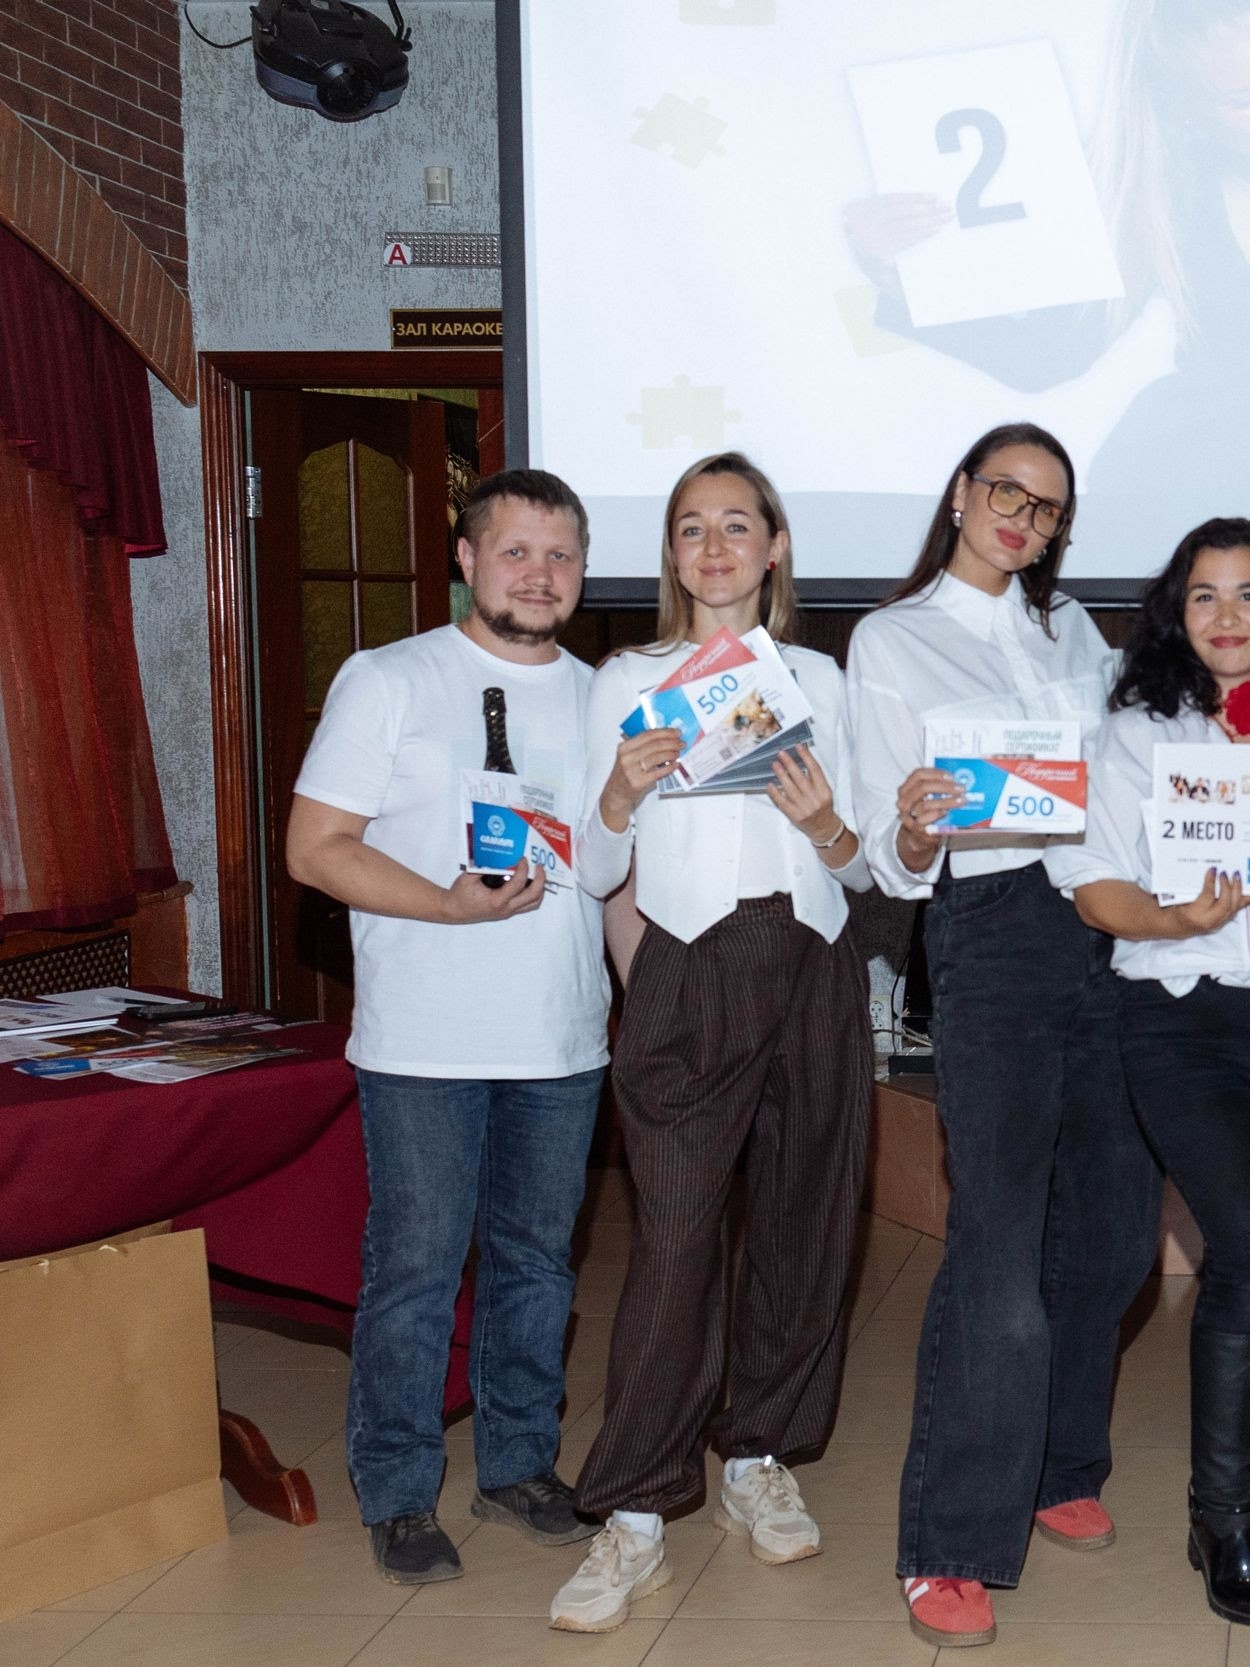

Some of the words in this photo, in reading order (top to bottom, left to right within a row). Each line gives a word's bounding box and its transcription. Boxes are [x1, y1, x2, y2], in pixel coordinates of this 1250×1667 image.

[934, 108, 1027, 229] 2
[396, 322, 427, 336] ЗАЛ
[431, 322, 503, 336] КАРАОКЕ
[697, 673, 740, 716] 500
[1006, 796, 1055, 817] 500
[1162, 820, 1175, 839] 2
[1181, 821, 1235, 841] МЕСТО
[531, 845, 556, 870] 500
